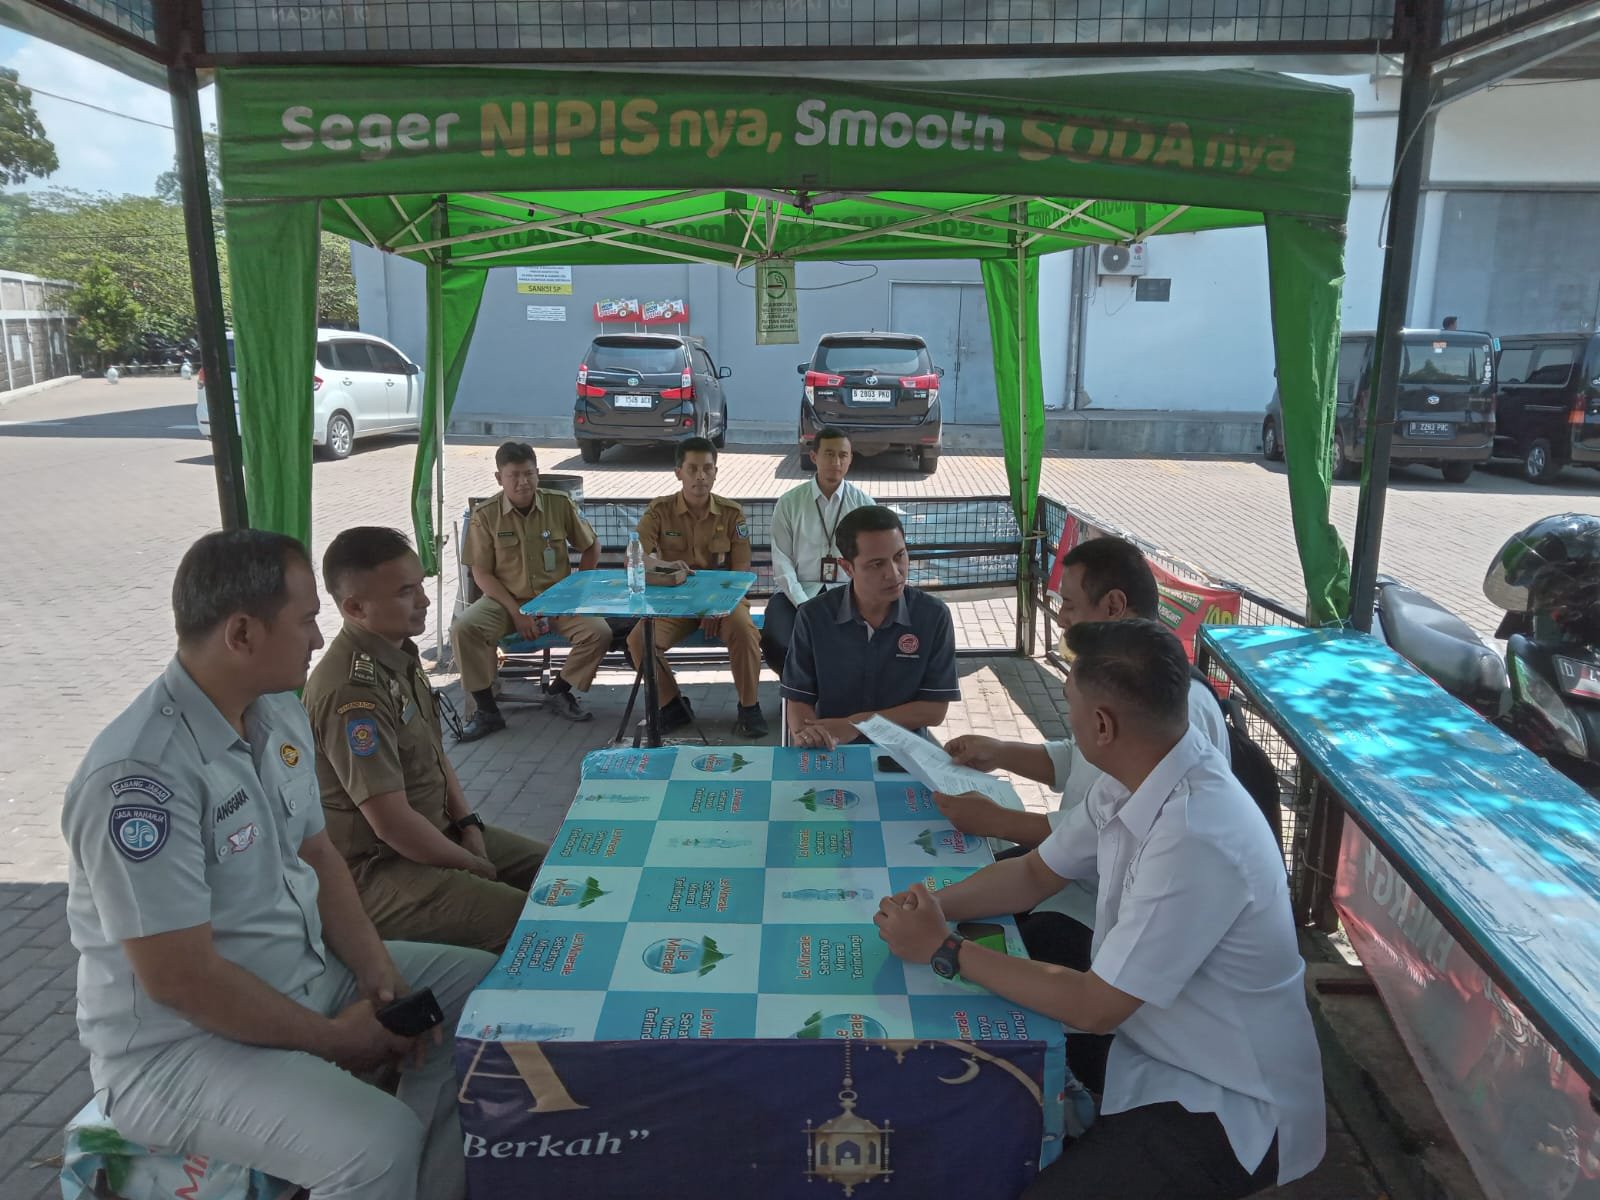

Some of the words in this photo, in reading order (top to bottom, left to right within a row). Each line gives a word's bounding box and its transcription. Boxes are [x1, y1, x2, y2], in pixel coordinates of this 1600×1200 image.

[280, 105, 460, 161] Seger
[480, 99, 659, 158] NIPIS
[669, 107, 782, 158] nya,
[794, 99, 1005, 152] Smooth
[115, 810, 133, 820] JASA
[133, 810, 165, 823] RAHARJA
[215, 787, 250, 824] ANGGARA
[660, 937, 682, 974] Minerale
[677, 949, 694, 961] Le
[640, 1007, 660, 1041] Terlind
[659, 1016, 676, 1041] Mine
[850, 1014, 864, 1040] erale
[953, 1010, 972, 1041] nerale
[993, 1019, 1011, 1041] eral
